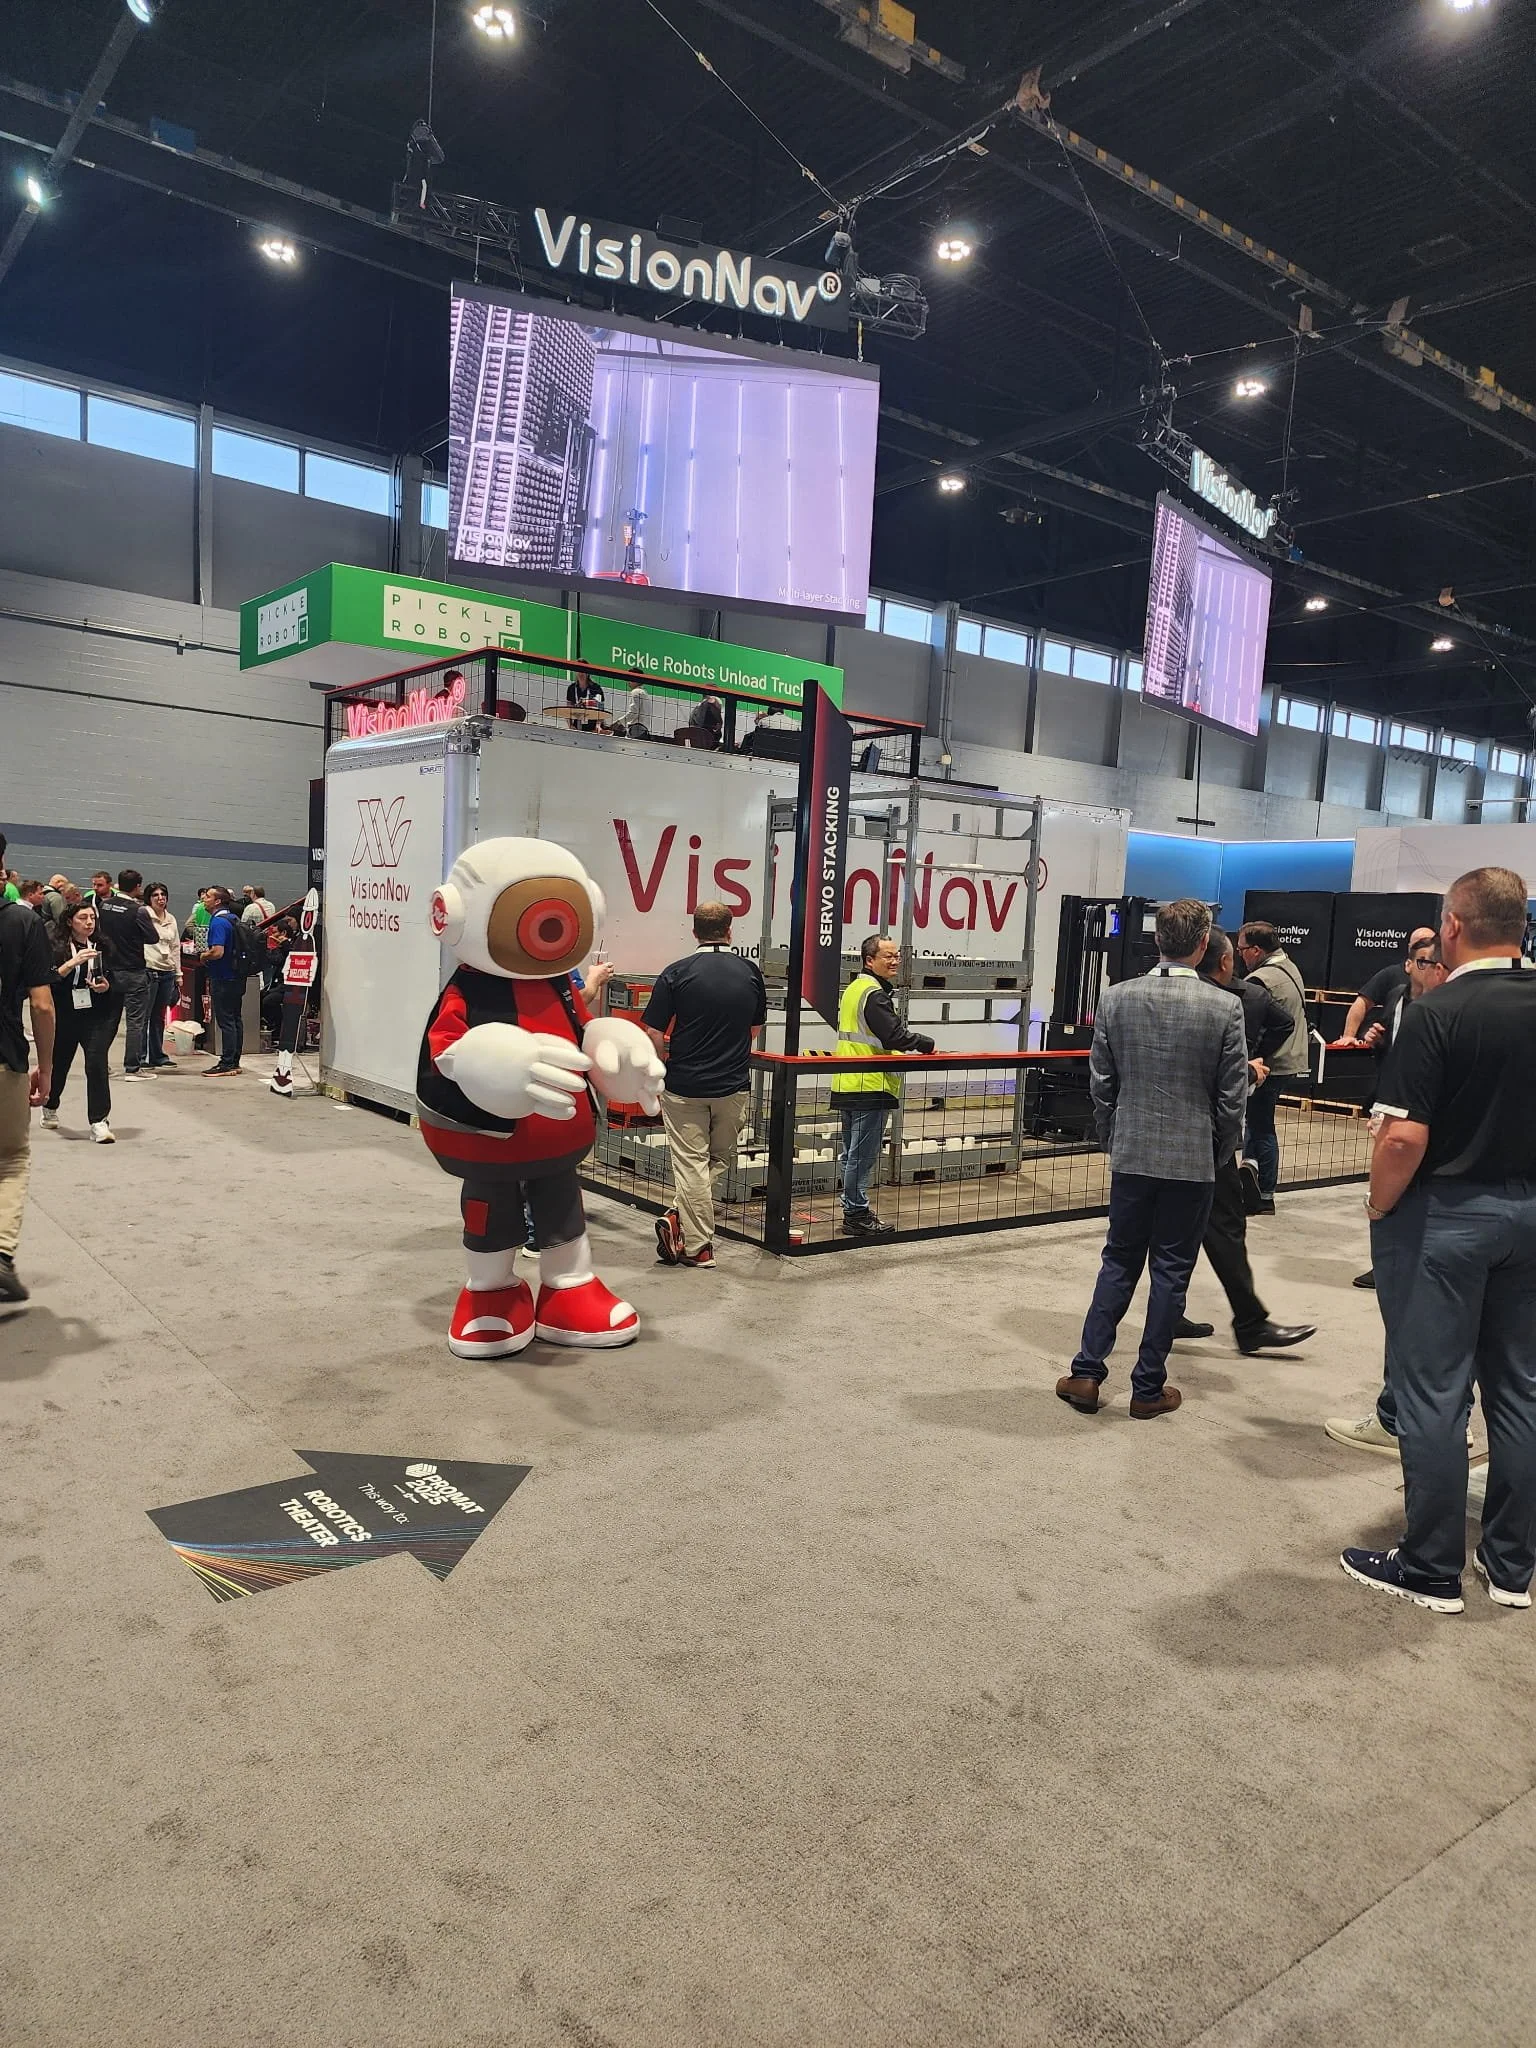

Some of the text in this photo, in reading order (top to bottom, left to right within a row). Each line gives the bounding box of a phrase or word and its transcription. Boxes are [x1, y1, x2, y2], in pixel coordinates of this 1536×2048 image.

[260, 596, 305, 625] PICKLE
[392, 594, 513, 628] PICKLE
[260, 624, 296, 648] ROBOT
[392, 619, 493, 647] ROBOT
[611, 646, 659, 670] Pickle
[663, 655, 715, 680] Robots
[719, 666, 767, 691] Unload
[819, 786, 840, 948] SERVO STACKING
[350, 876, 411, 903] VisionNav
[349, 904, 400, 932] Robotics
[1355, 938, 1399, 949] Robotics
[1356, 927, 1408, 939] VisionNav
[405, 1479, 449, 1505] 2025
[422, 1474, 486, 1514] PROMAT
[279, 1498, 340, 1548] THEATER
[303, 1489, 372, 1542] ROBOTICS
